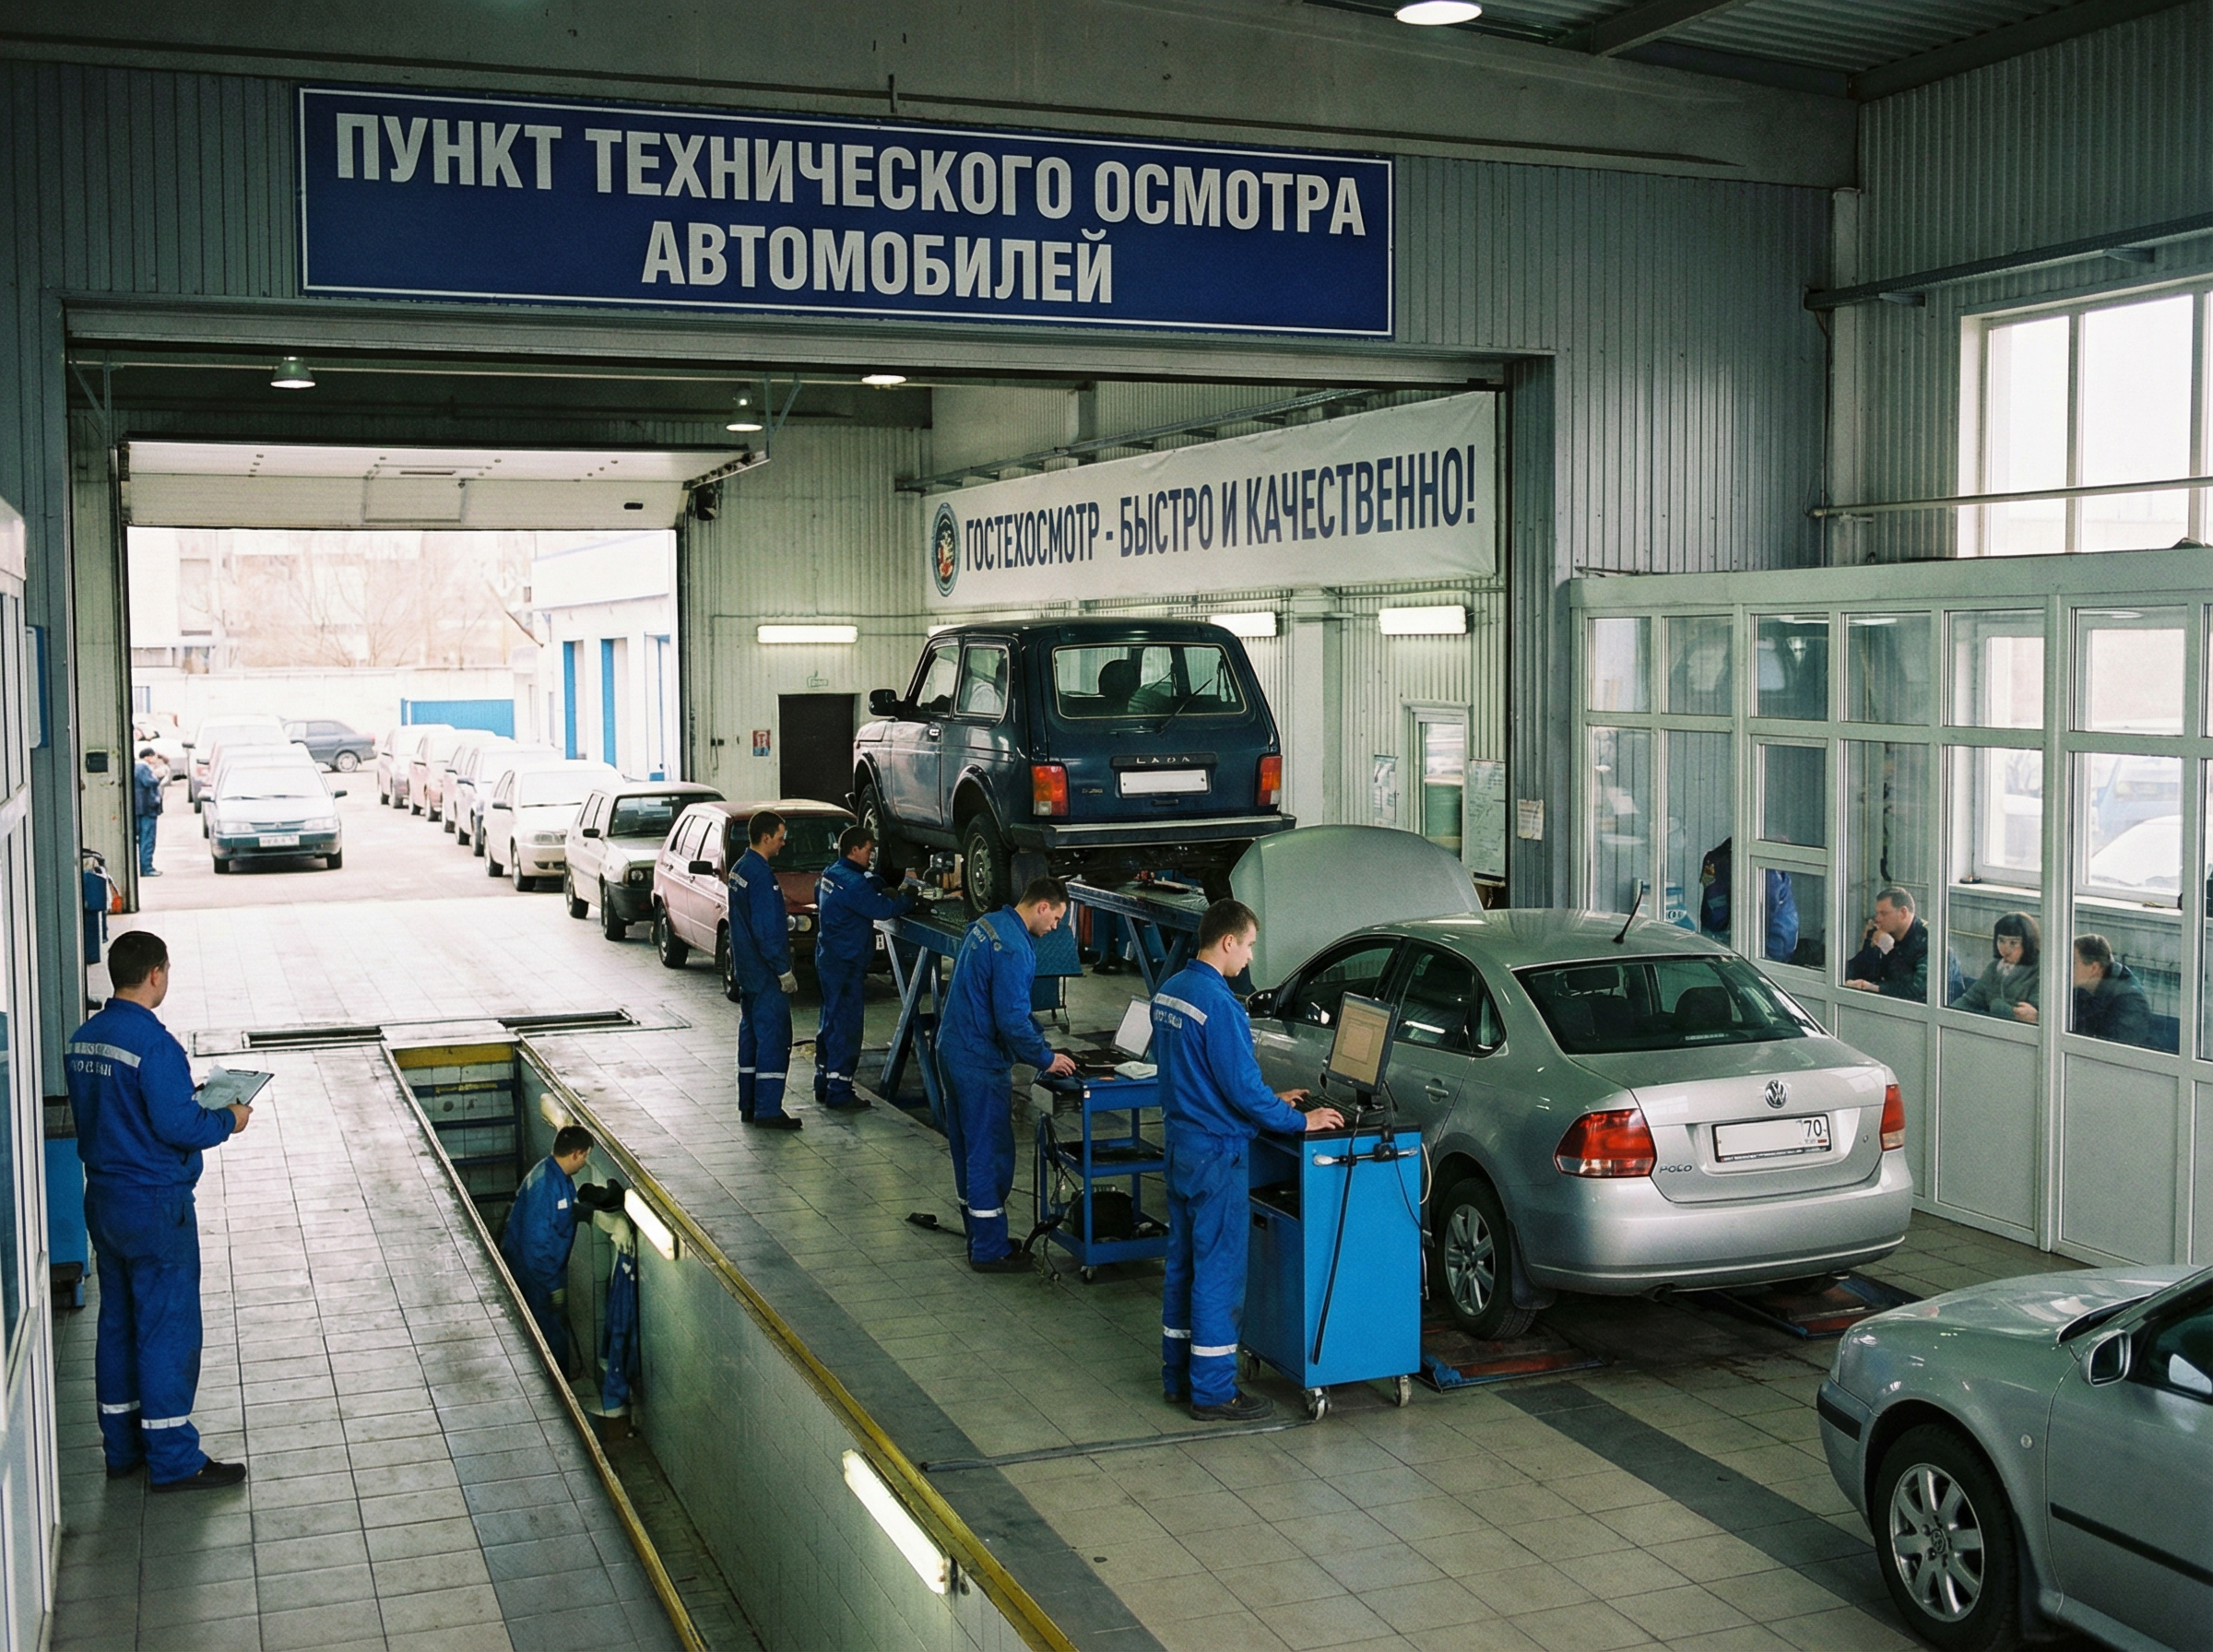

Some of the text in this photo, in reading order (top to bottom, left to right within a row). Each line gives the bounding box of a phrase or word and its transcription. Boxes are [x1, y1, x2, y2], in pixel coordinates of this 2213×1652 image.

[337, 112, 1367, 236] ПУНКТ ТЕХНИЧЕСКОГО ОСМОТРА
[641, 220, 1112, 304] АВТОМОБИЛЕЙ
[965, 502, 1100, 572] ГОСТЕХОСМОТР
[1119, 483, 1213, 558] БЫСТРО
[1222, 480, 1237, 548] И
[1246, 443, 1475, 546] КАЧЕСТВЕННО!
[1659, 1163, 1693, 1174] POLO
[1804, 1119, 1822, 1137] 70
